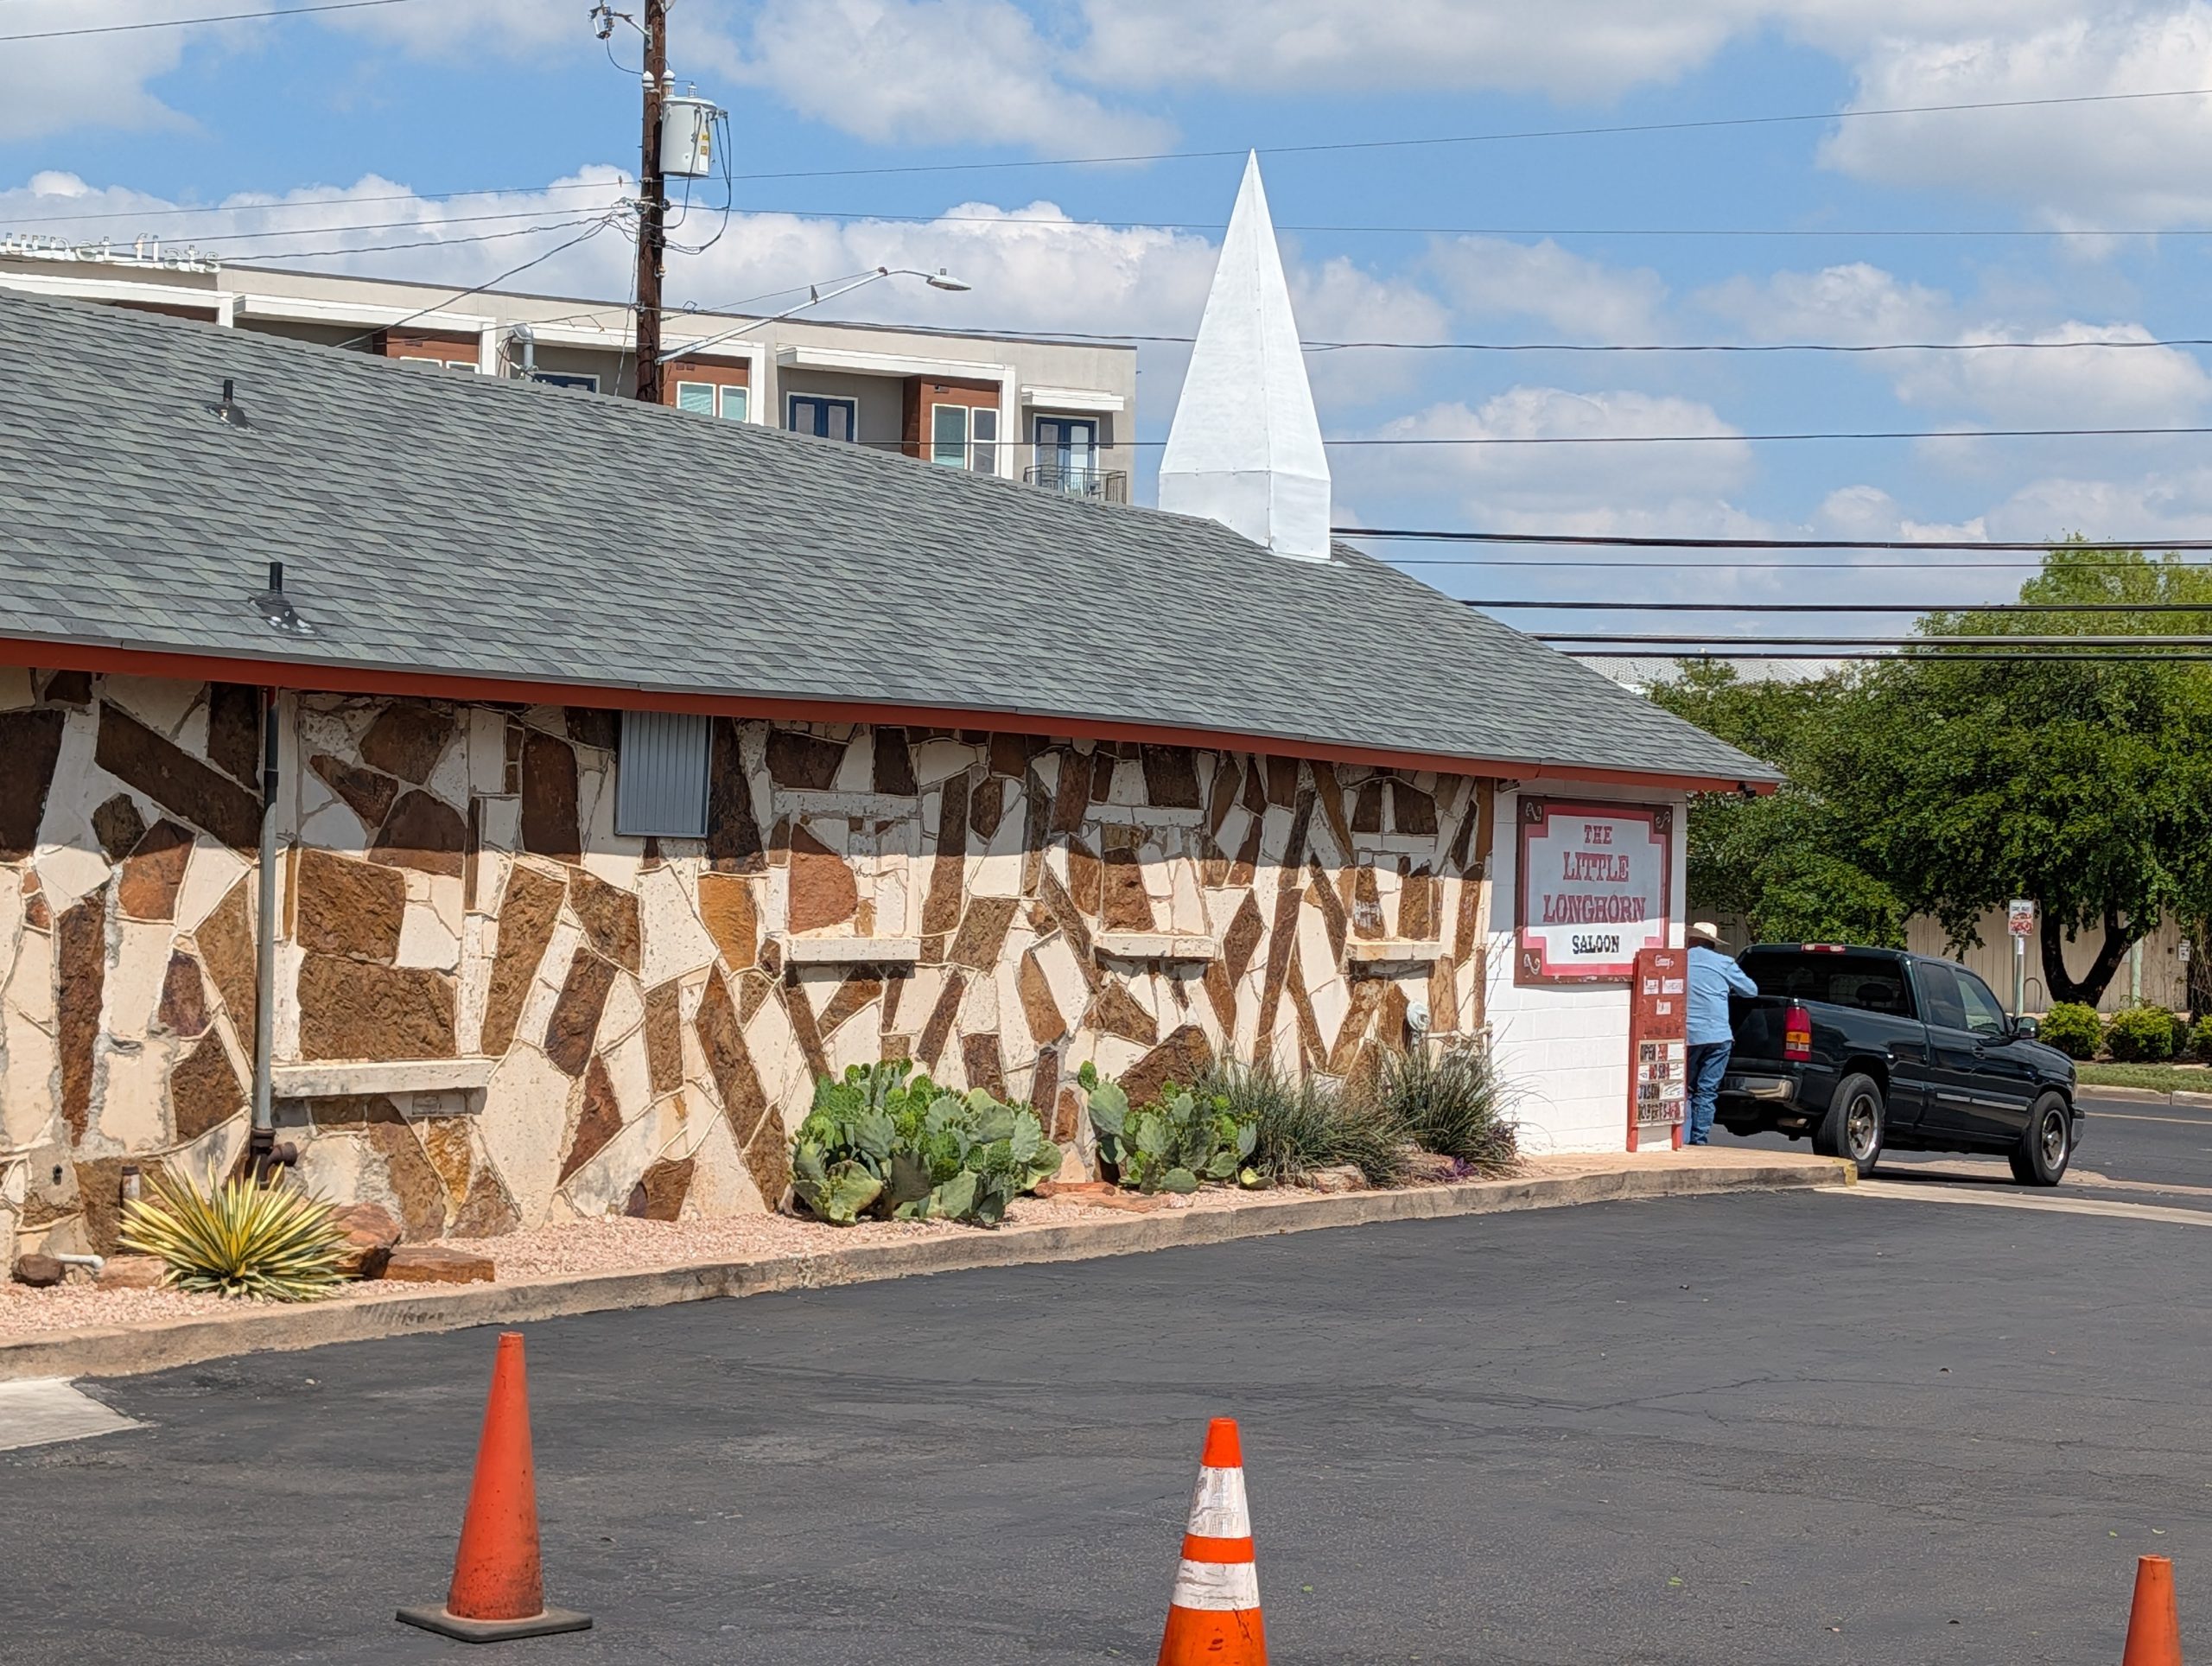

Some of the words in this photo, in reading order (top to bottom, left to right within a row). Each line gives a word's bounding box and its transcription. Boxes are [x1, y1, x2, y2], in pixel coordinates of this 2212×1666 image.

[132, 232, 222, 274] flats
[1584, 824, 1612, 844] THE
[1563, 851, 1629, 882] LITTLE
[1542, 893, 1646, 924] LONGHORN
[1572, 934, 1619, 955] SALOON
